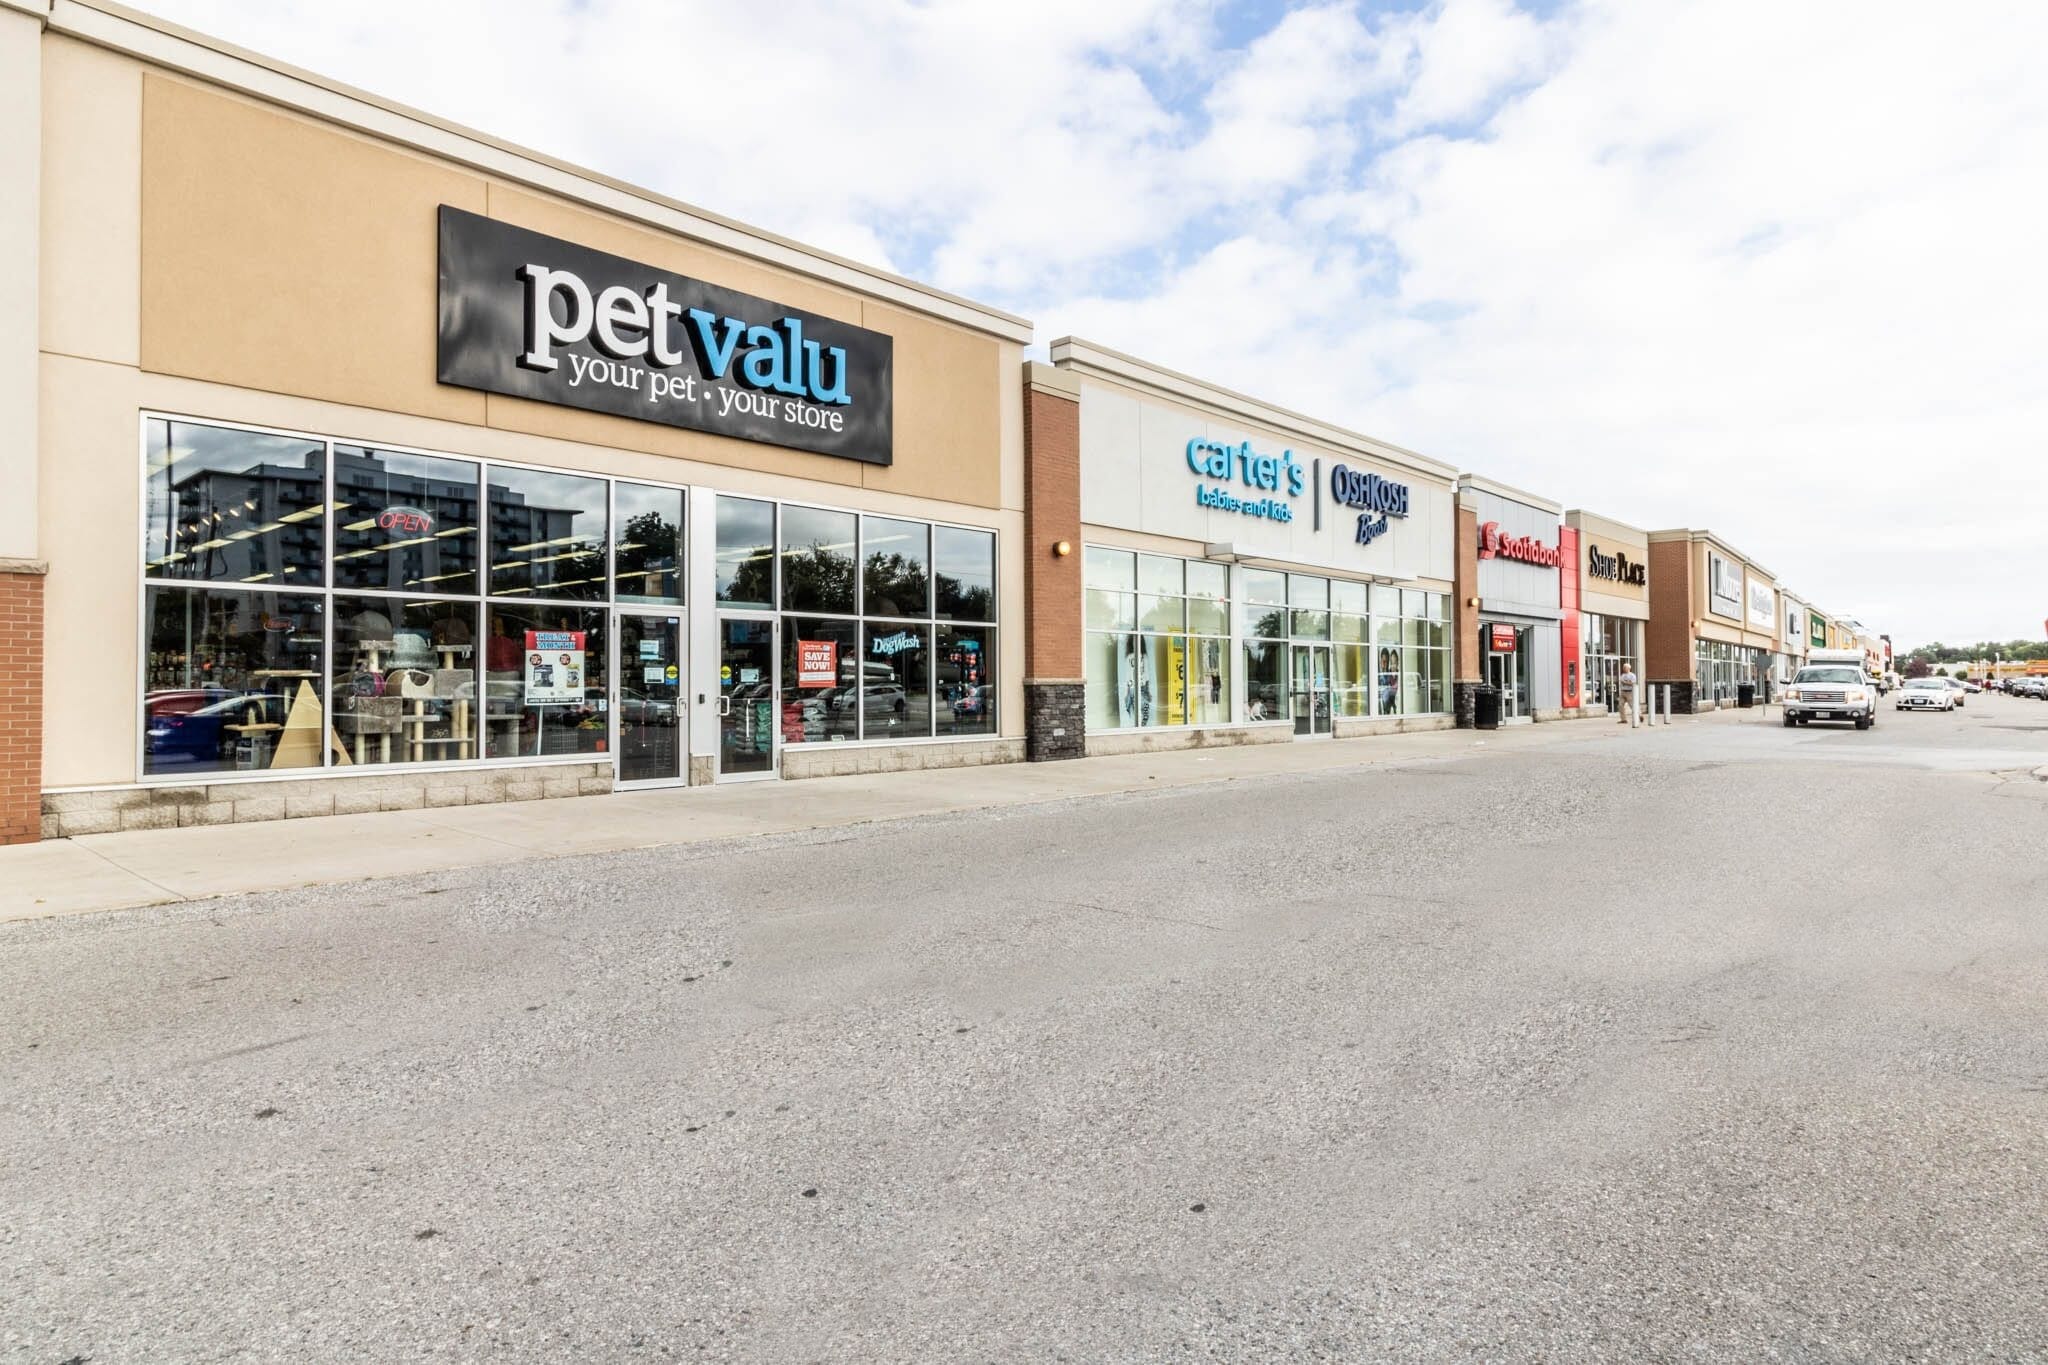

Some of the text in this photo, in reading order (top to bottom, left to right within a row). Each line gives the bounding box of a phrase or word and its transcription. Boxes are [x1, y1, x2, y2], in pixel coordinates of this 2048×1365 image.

[517, 262, 852, 406] pet valu
[567, 352, 844, 432] your pet your store
[1187, 437, 1304, 497] carter's
[380, 512, 431, 531] OPEN
[1197, 484, 1295, 523] babies and kids
[1500, 531, 1567, 569] Scotiabank
[804, 651, 831, 661] SAVE
[804, 661, 831, 670] NOW!
